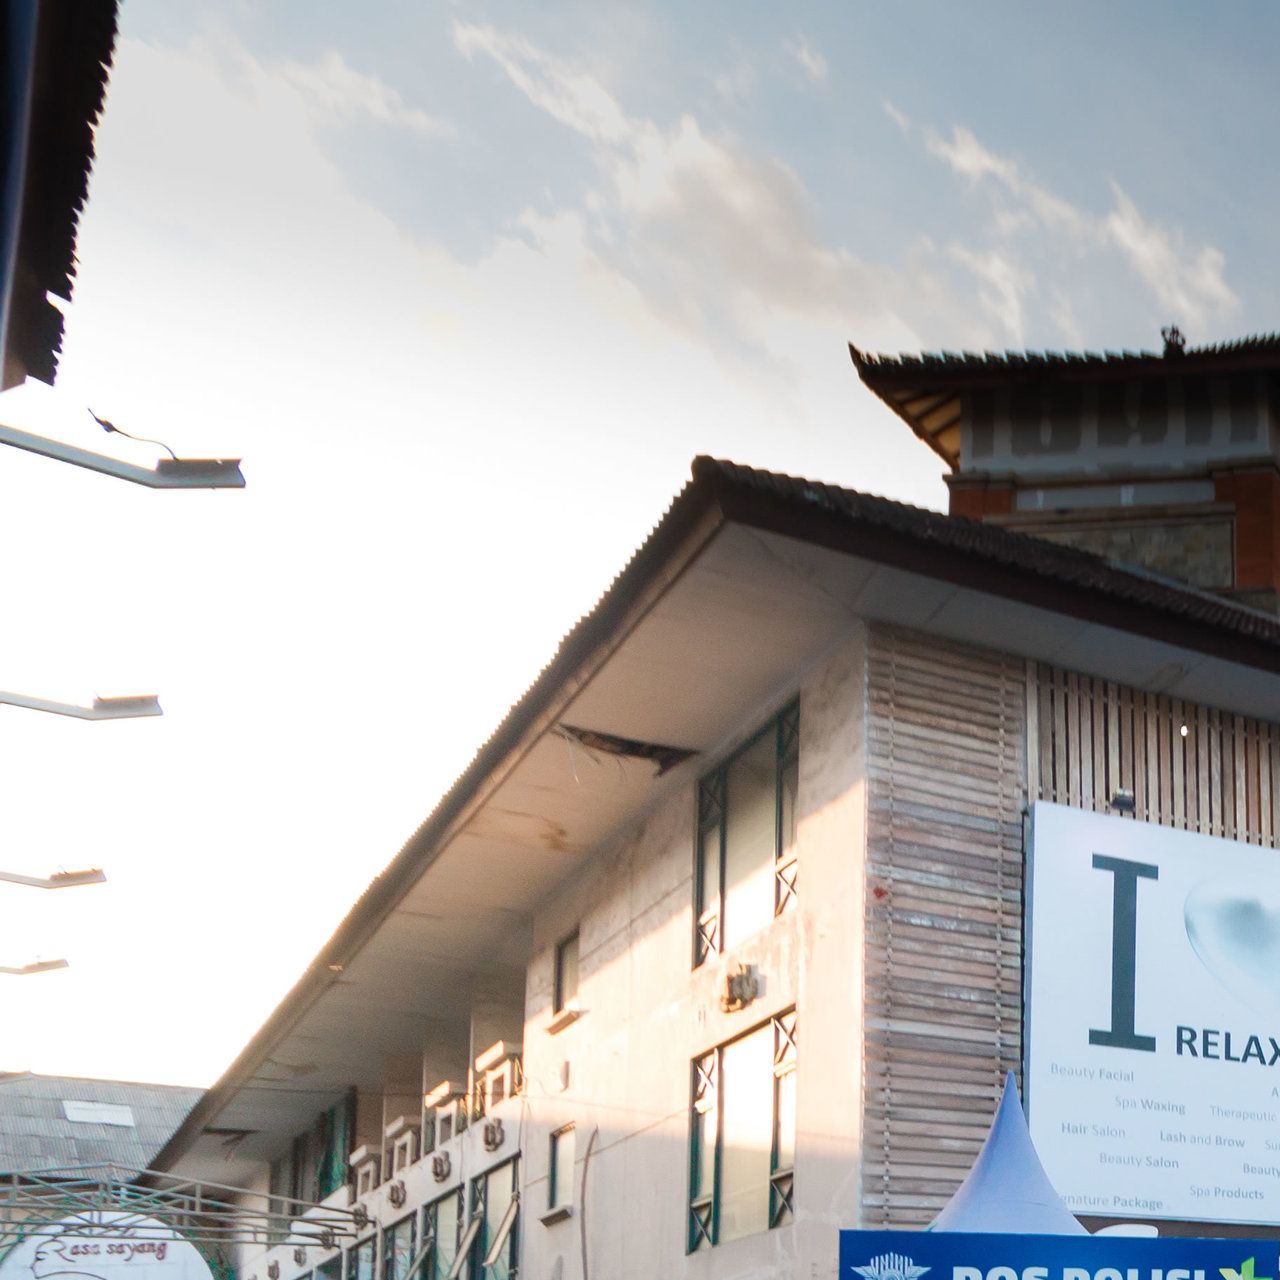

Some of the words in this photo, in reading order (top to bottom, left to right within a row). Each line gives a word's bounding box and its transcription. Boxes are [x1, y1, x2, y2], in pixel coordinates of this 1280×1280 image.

[1088, 853, 1159, 1053] I
[1050, 1063, 1095, 1077] Beauty
[1099, 1068, 1134, 1082] Facial
[1115, 1096, 1138, 1109] Spa
[1140, 1099, 1186, 1115] Waxing
[1210, 1105, 1276, 1122] Therapeutic
[1061, 1122, 1088, 1135] Hair
[1091, 1124, 1126, 1138] Salon
[1160, 1130, 1187, 1143] Lash
[1189, 1133, 1212, 1146] and
[1214, 1134, 1246, 1149] Brow
[1099, 1152, 1142, 1168] Beauty
[1146, 1155, 1180, 1169] Salon
[1190, 1184, 1211, 1198] Spa
[1213, 1186, 1265, 1201] Products
[1112, 1195, 1164, 1212] Package
